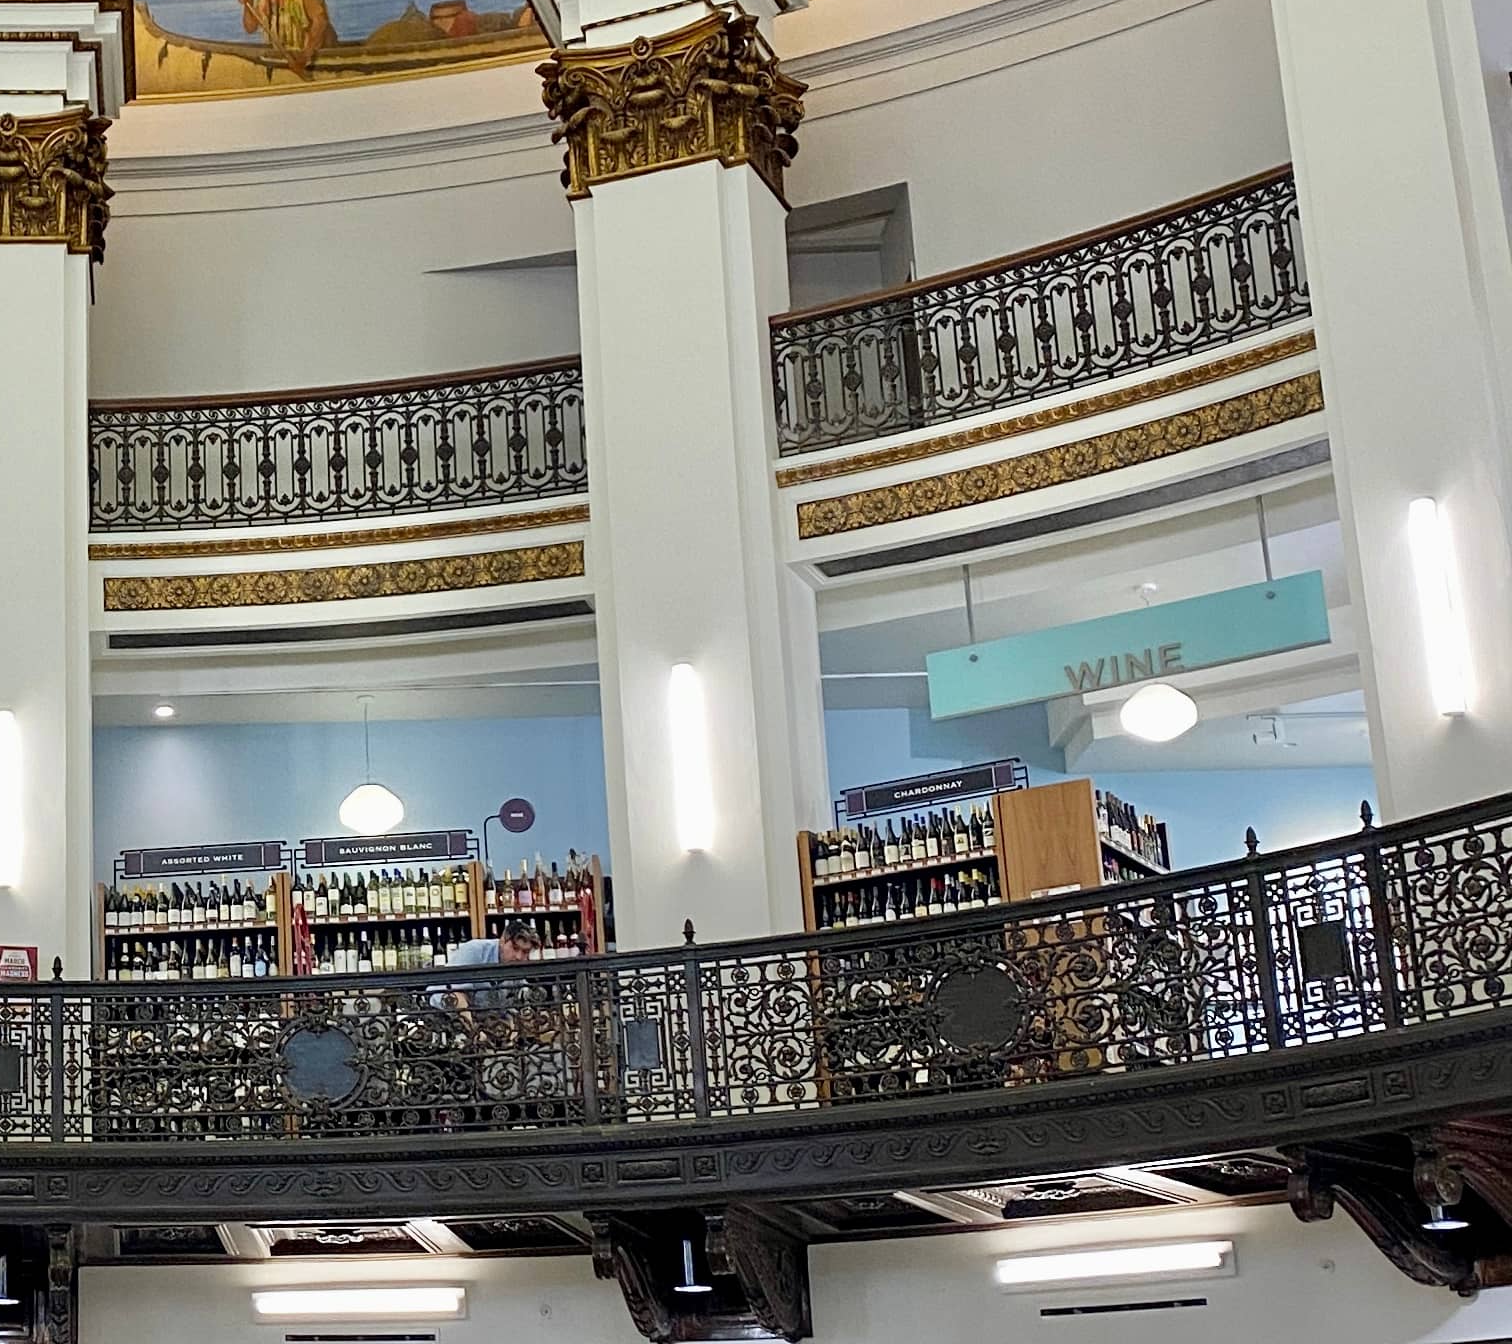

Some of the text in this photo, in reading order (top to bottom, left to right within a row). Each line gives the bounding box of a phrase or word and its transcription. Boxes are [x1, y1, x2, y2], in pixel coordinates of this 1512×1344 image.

[1063, 641, 1185, 692] WINE
[893, 780, 963, 799] CHARDONNAY
[339, 842, 433, 855] SAUVIGNON BLANC
[161, 854, 244, 866] ASSORTED WHITE
